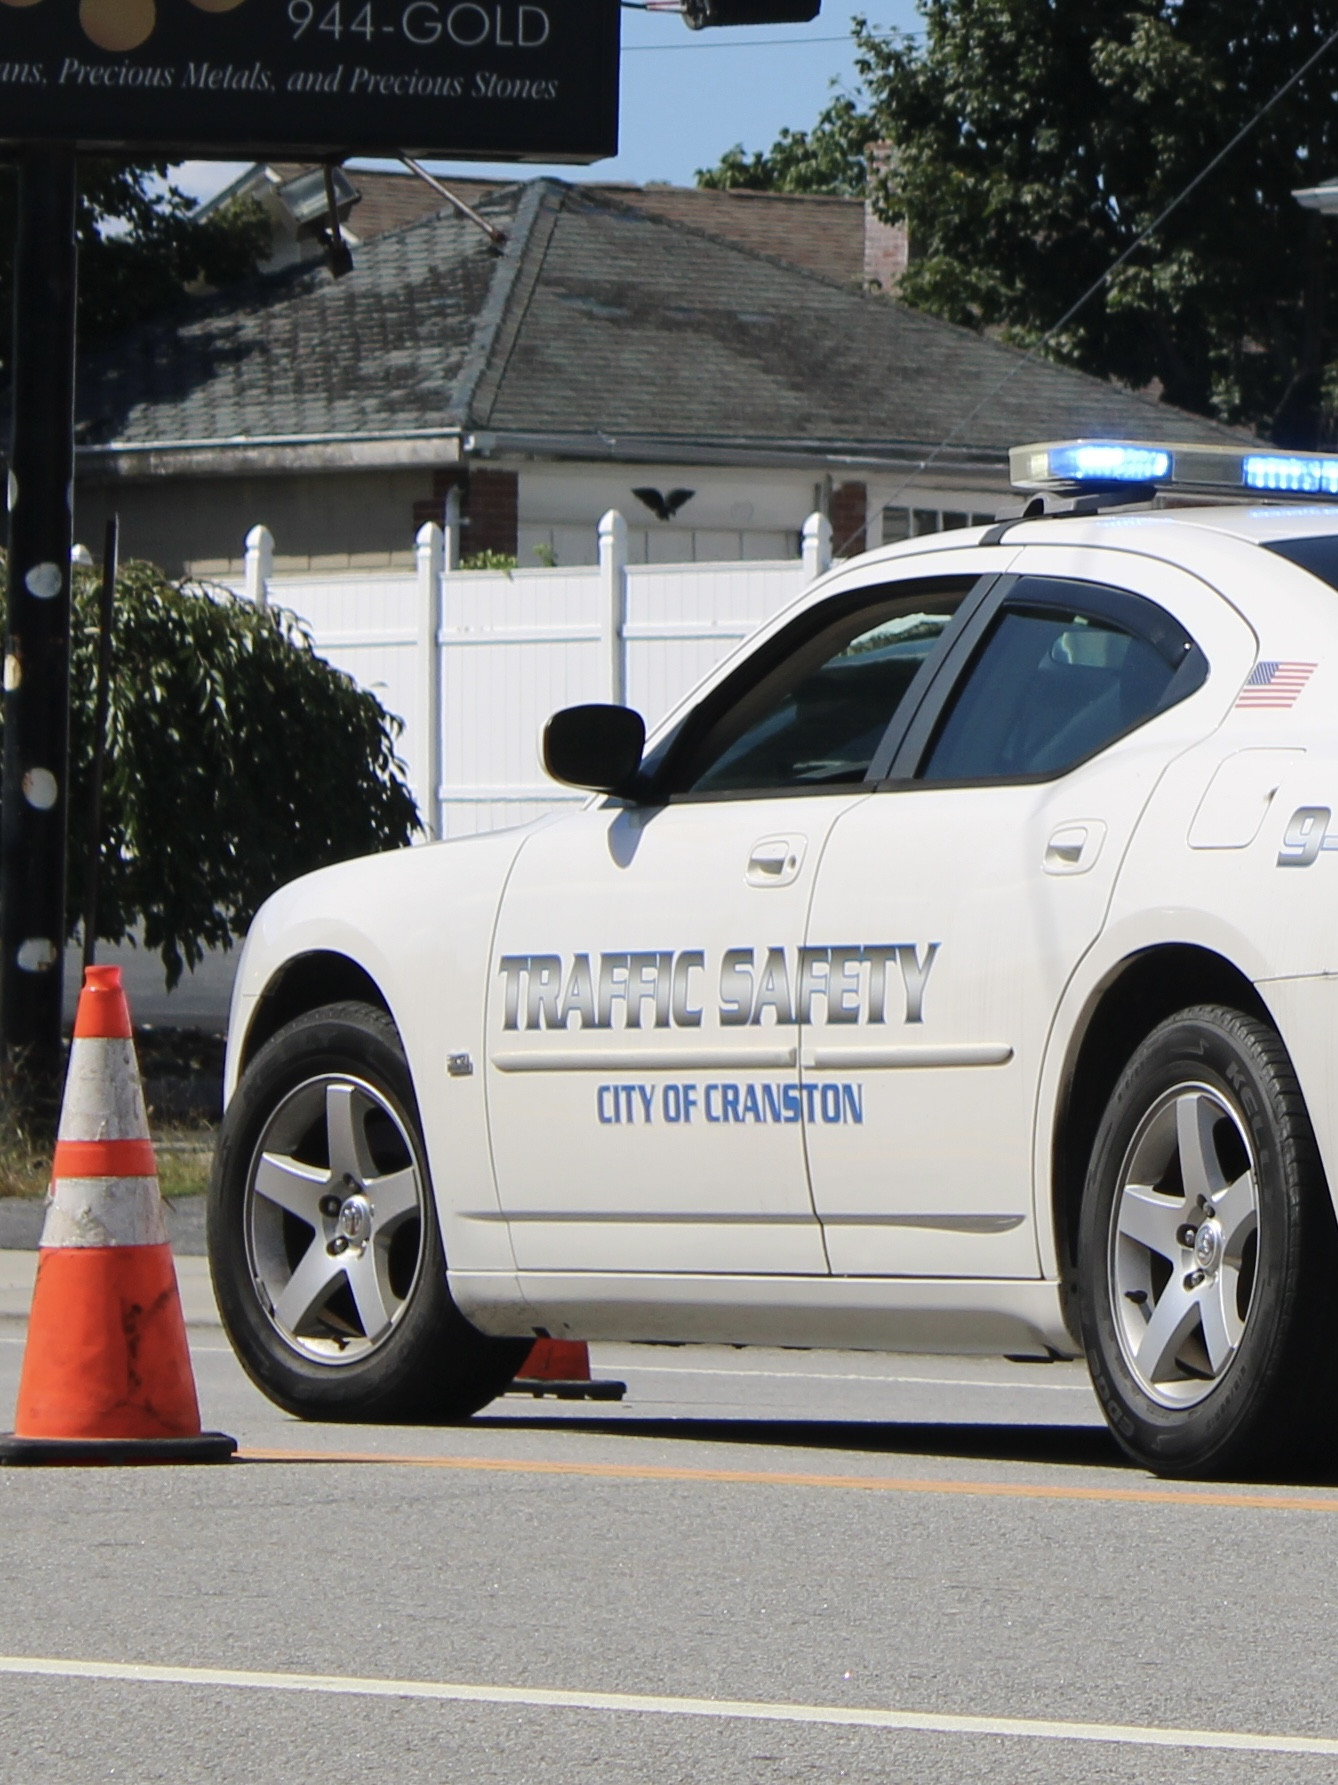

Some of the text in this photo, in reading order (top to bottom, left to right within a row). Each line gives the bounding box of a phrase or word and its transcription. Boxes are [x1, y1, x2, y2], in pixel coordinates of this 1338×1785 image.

[287, 0, 550, 46] 944-GOLD
[59, 57, 174, 87] Precious
[181, 62, 276, 91] Metals,
[287, 64, 343, 92] and
[349, 67, 463, 97] Precious
[471, 71, 558, 99] Stones
[498, 942, 942, 1031] TRAFFIC SAFETY
[597, 1083, 864, 1125] CITY OF CRANSTON
